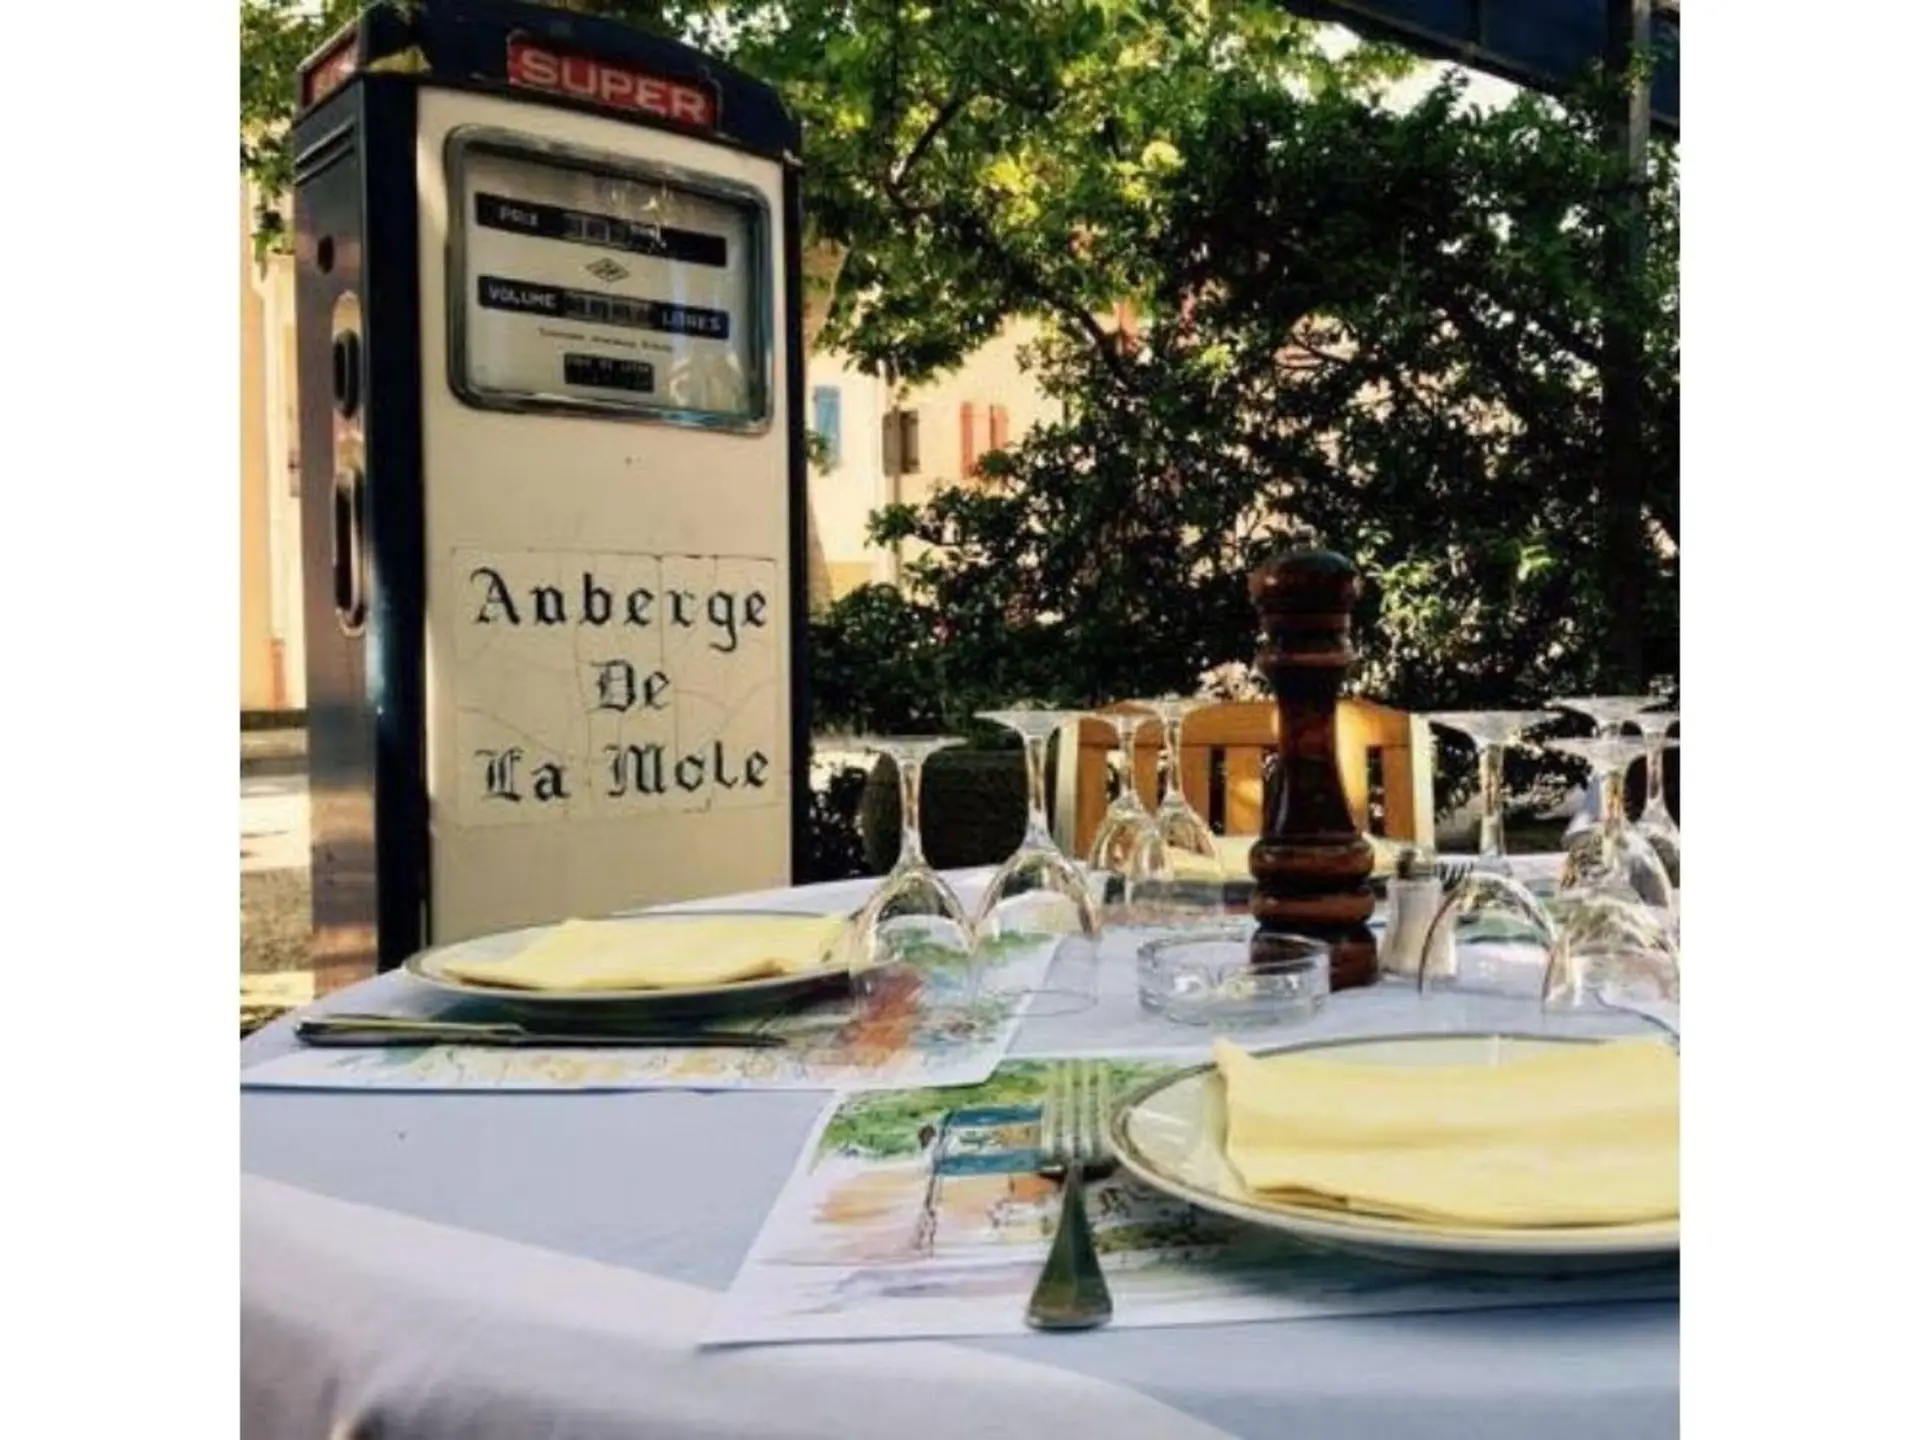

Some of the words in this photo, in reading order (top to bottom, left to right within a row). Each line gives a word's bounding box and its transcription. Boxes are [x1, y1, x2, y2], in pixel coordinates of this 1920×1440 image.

[520, 49, 707, 125] SUPER
[488, 283, 557, 310] VOLUME
[470, 566, 768, 652] Auberge
[591, 659, 670, 712] De
[475, 747, 571, 802] La
[601, 740, 769, 798] Mole
